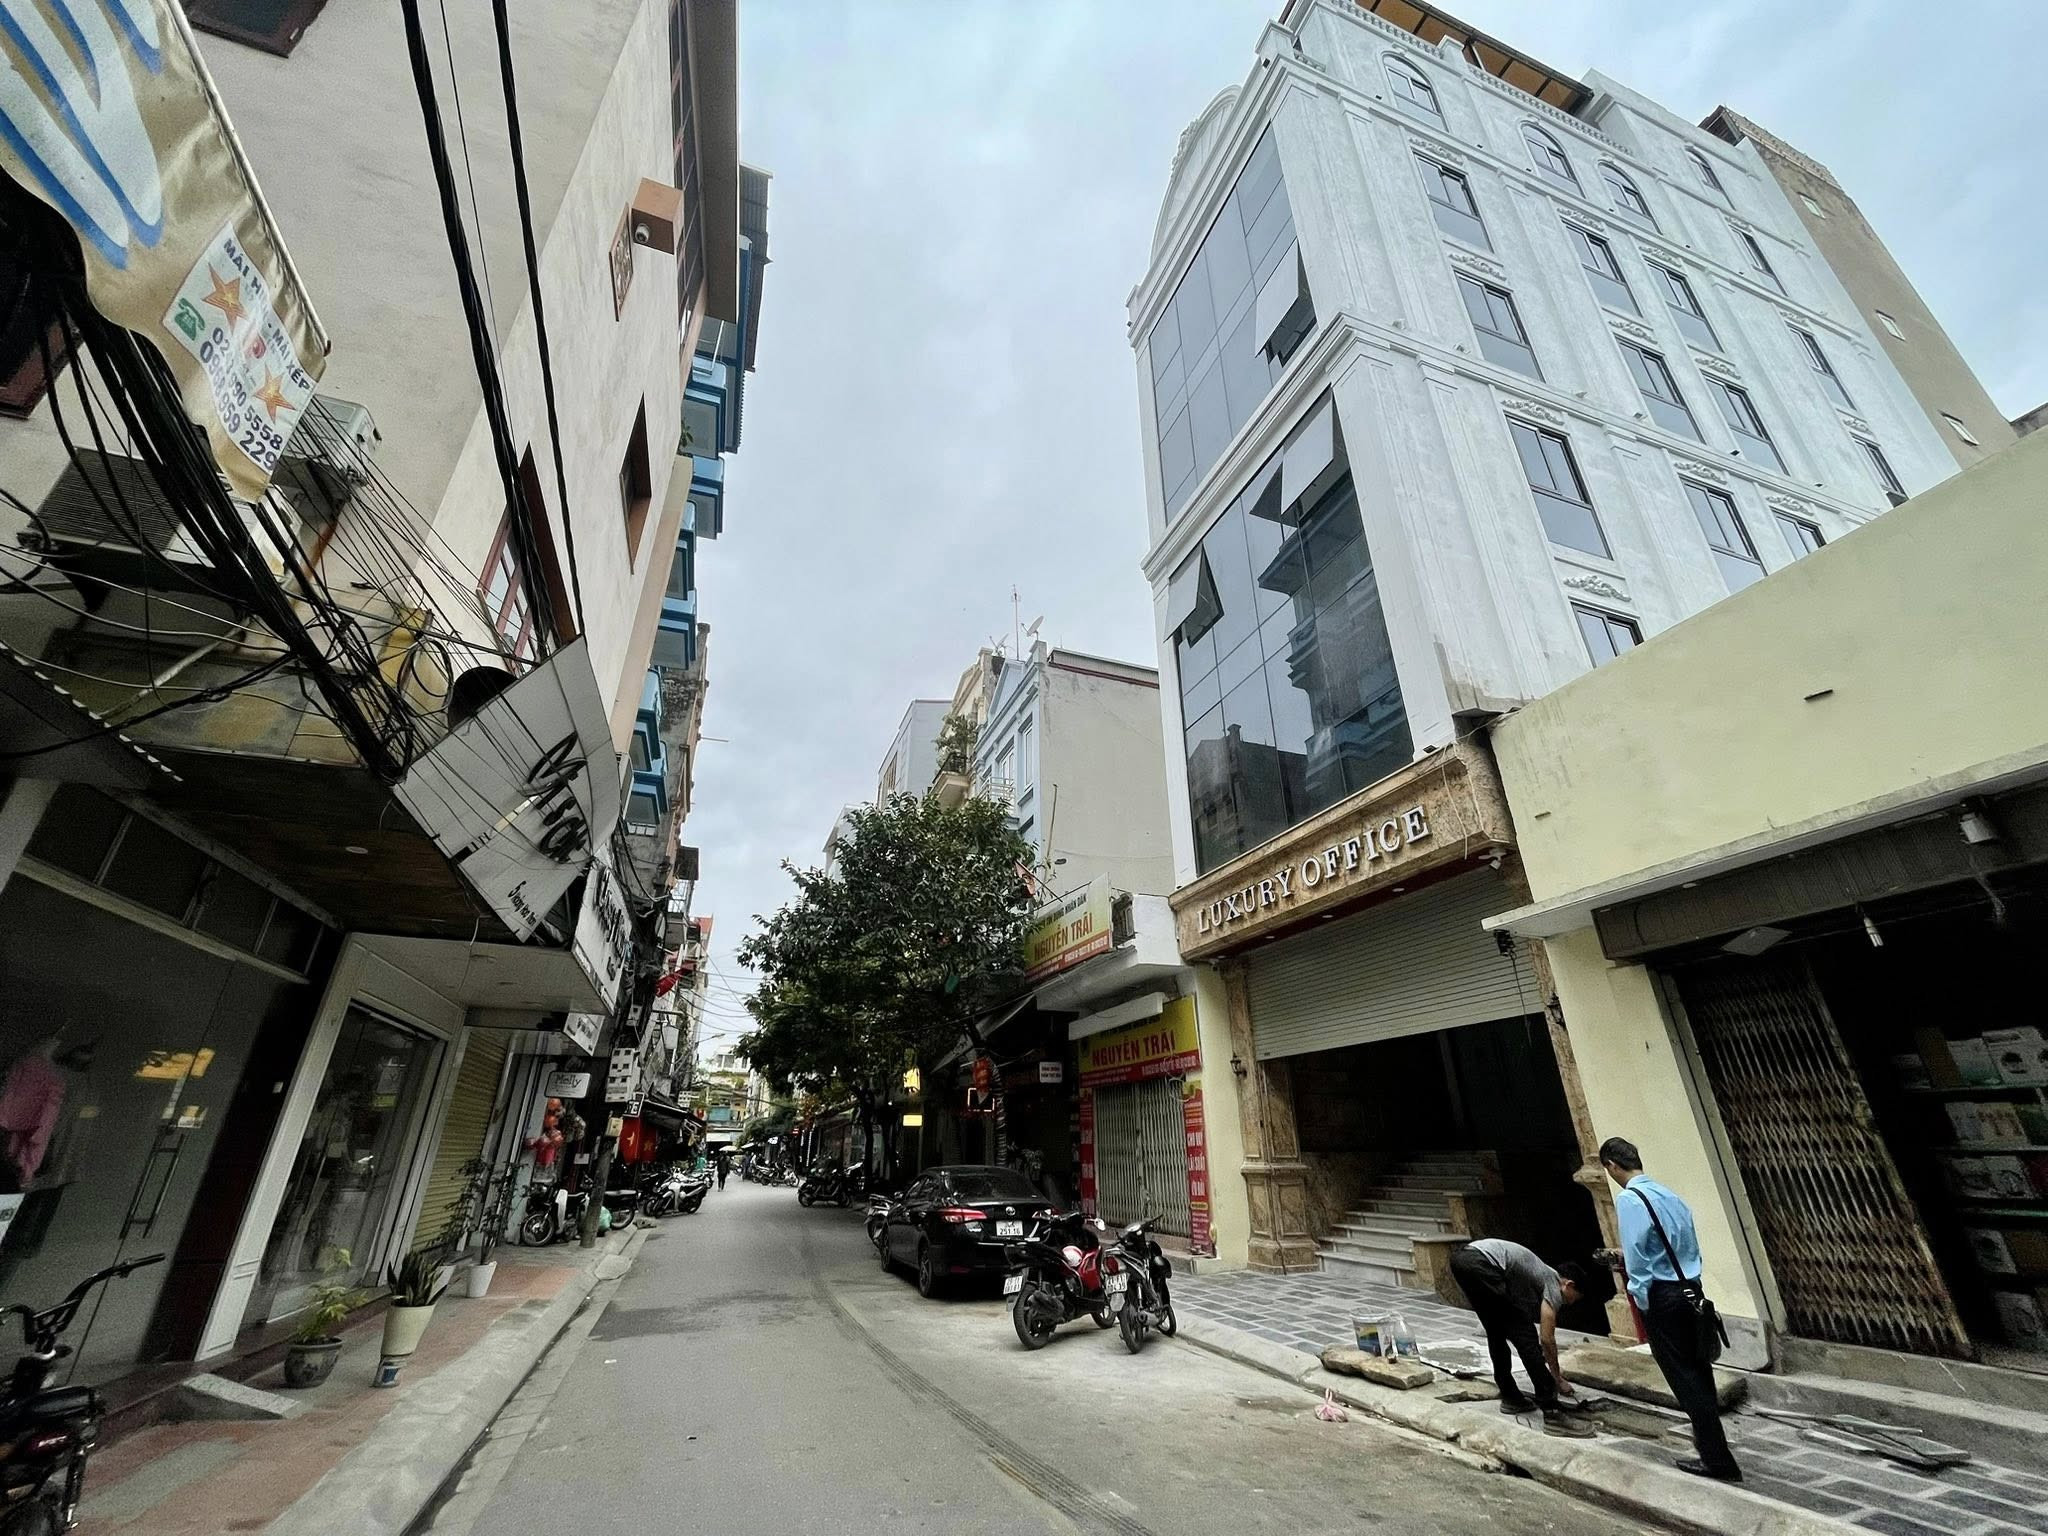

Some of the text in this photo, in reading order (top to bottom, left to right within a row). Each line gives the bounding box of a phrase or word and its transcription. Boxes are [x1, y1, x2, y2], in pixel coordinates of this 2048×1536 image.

[223, 238, 250, 277] MÁI
[272, 327, 291, 361] MÁI
[286, 360, 310, 390] XẾP
[239, 430, 278, 472] 229
[1197, 806, 1430, 933] LUXURY OFFICE
